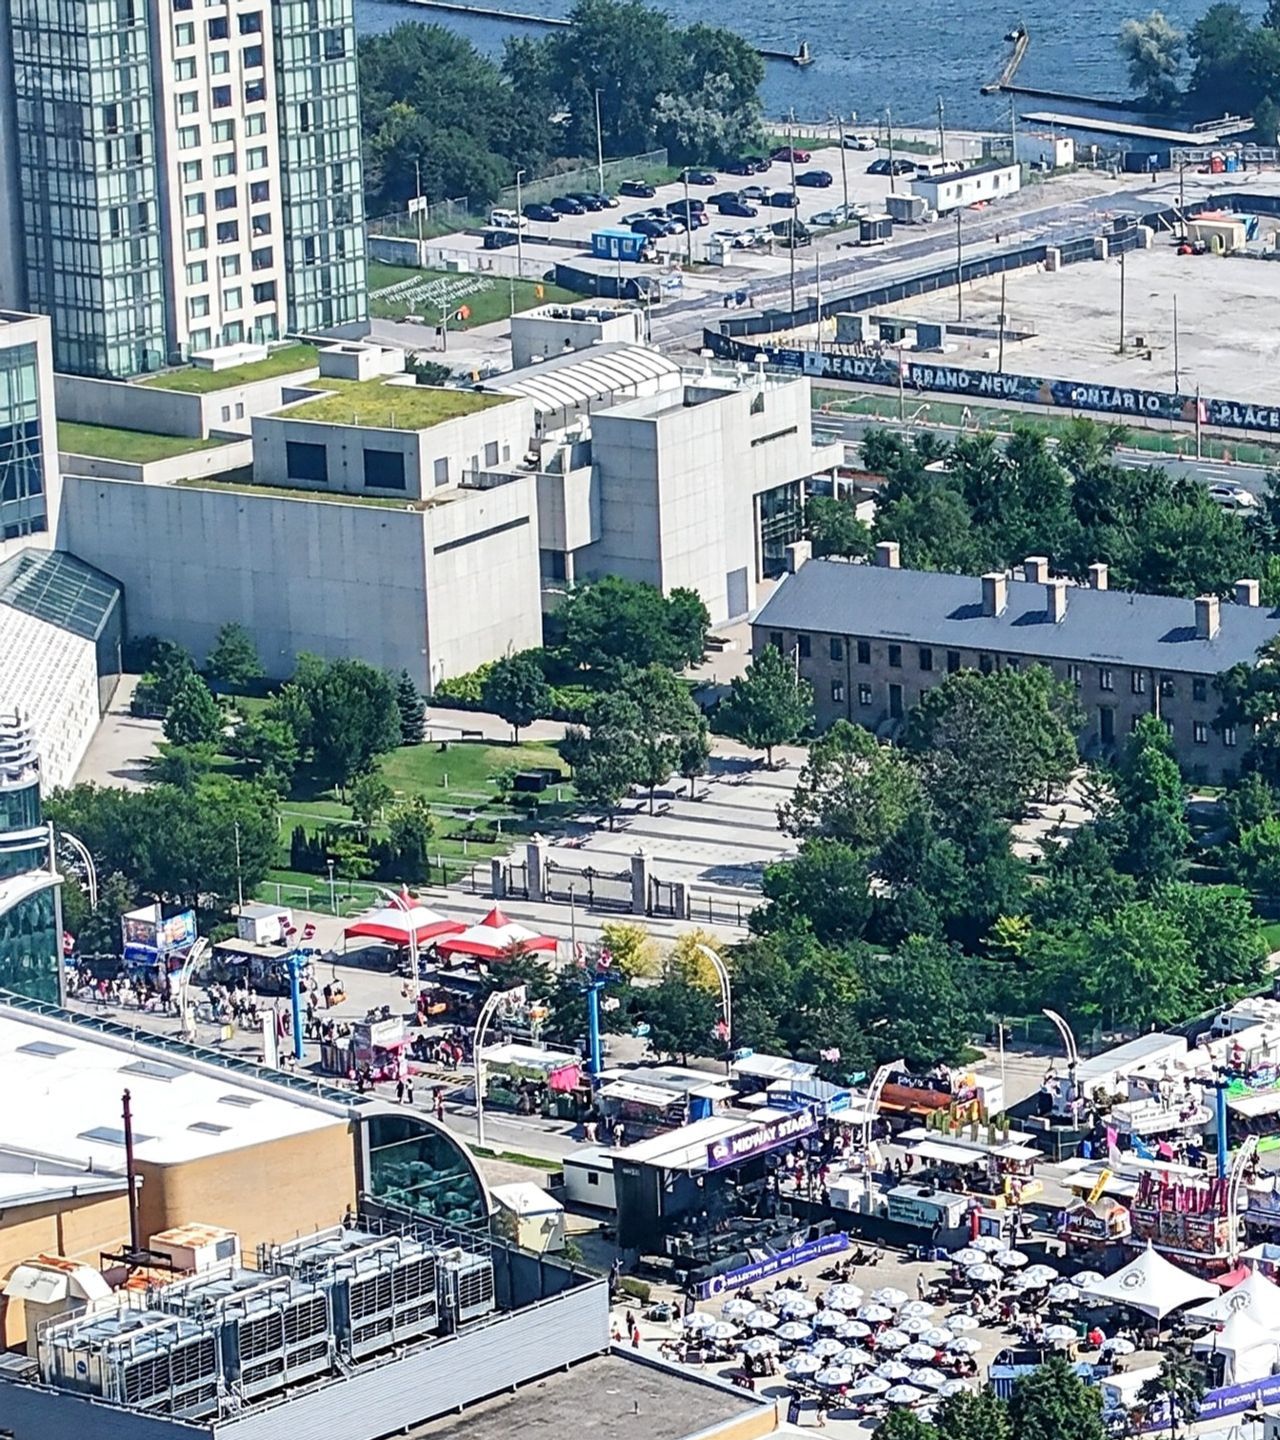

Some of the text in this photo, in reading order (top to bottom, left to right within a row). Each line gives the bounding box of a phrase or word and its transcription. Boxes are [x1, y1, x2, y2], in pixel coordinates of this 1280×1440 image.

[821, 356, 877, 378] READY
[912, 366, 1019, 394] BRAND-NEW
[1075, 386, 1161, 412] ONTARIO
